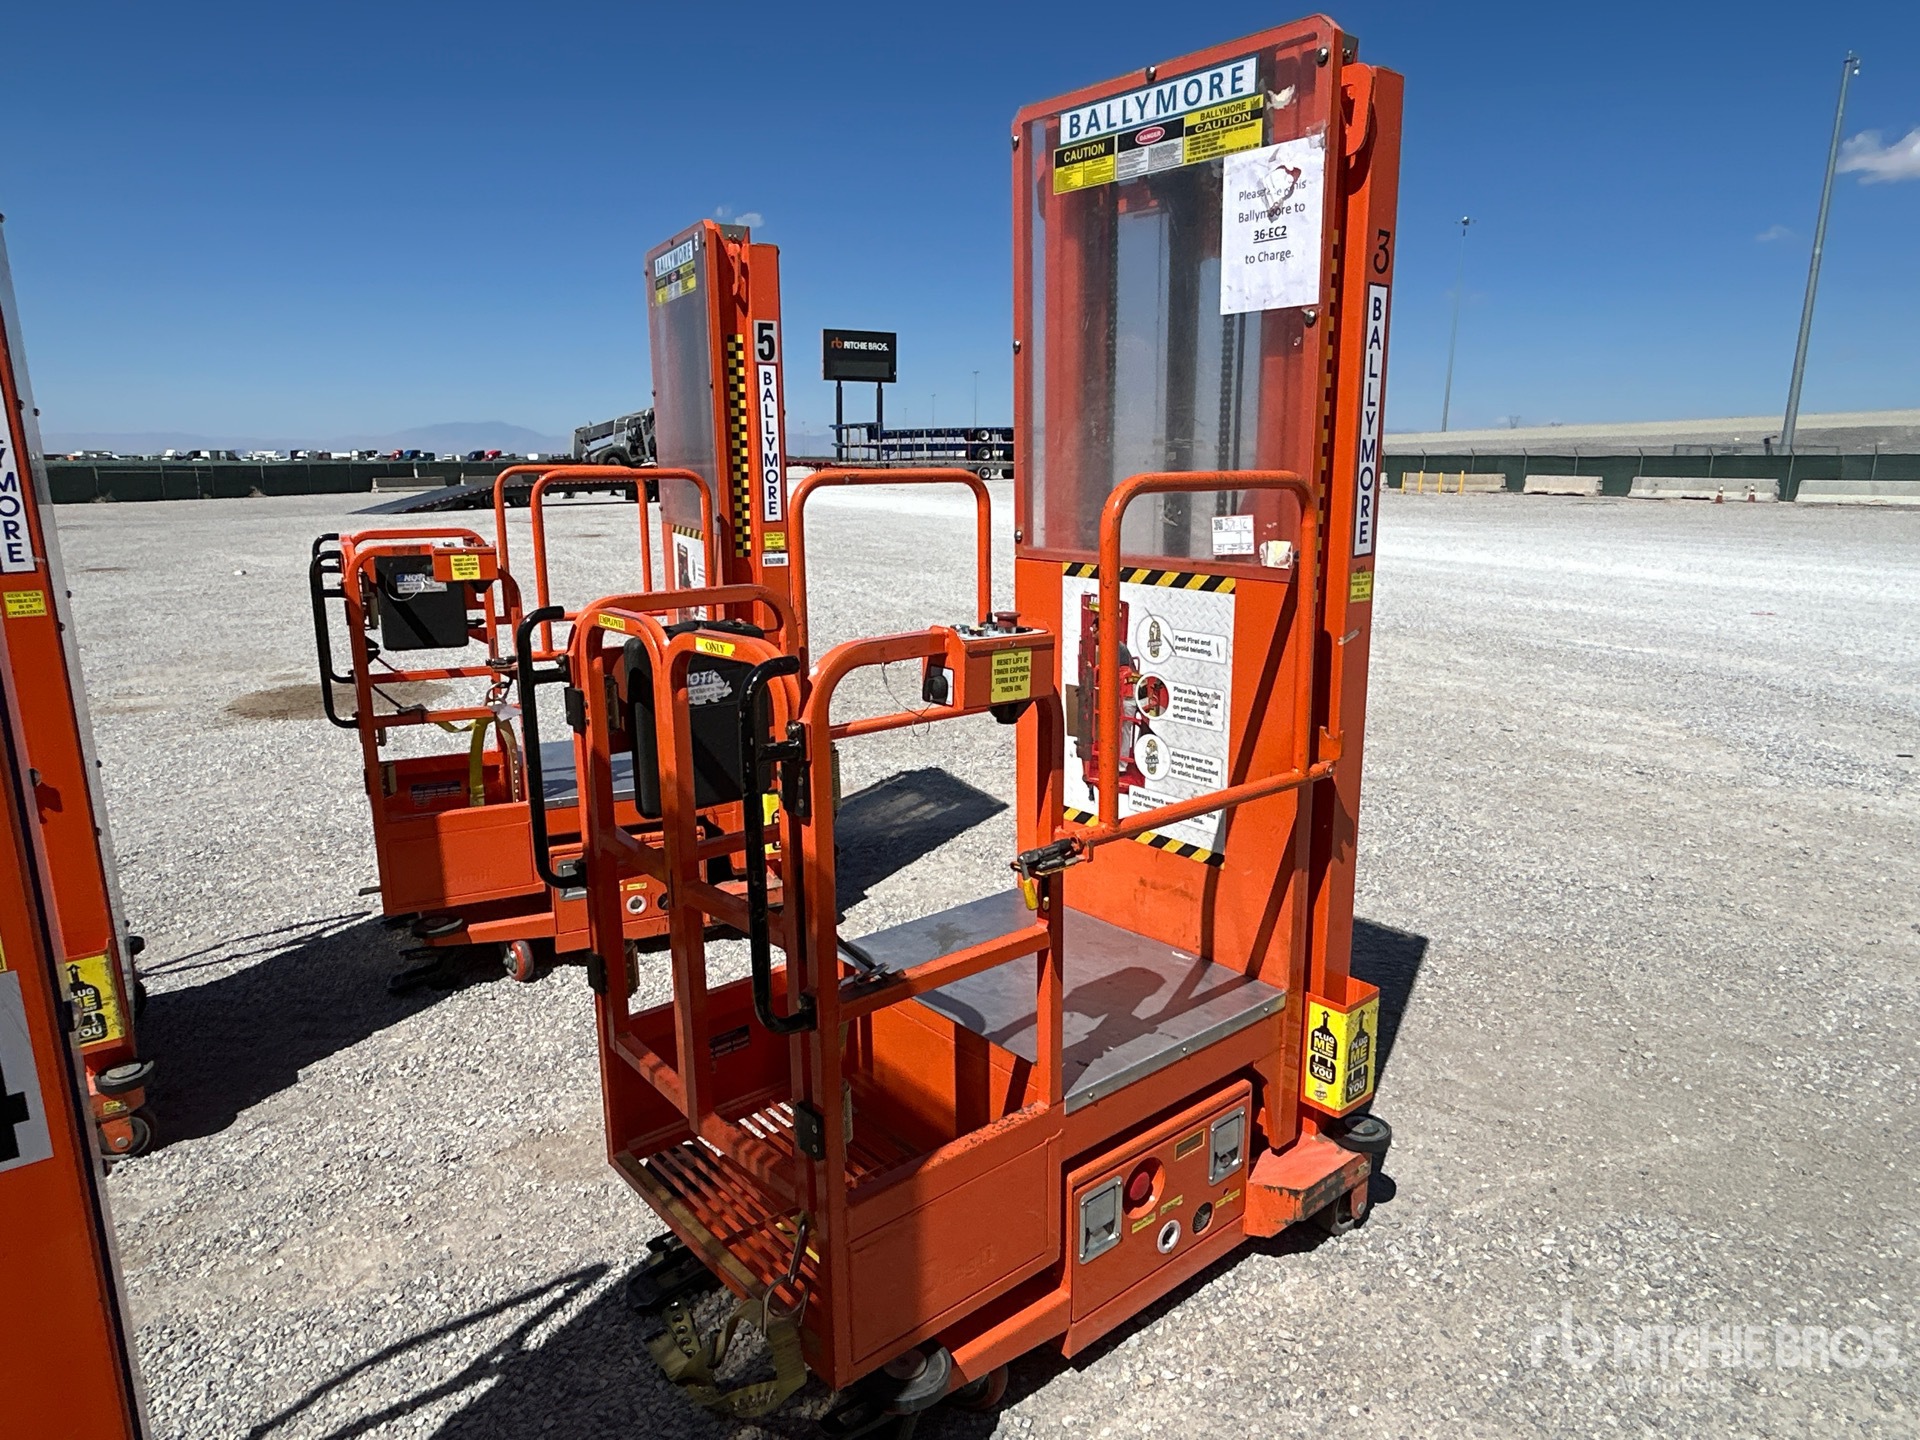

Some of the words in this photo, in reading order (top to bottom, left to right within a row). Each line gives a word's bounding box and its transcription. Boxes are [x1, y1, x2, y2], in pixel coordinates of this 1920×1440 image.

[1069, 65, 1245, 138] BALLYMORE
[1200, 102, 1246, 121] BALLYMORE
[1195, 112, 1251, 133] CAUTION
[1139, 130, 1162, 142] DANGER
[1064, 142, 1105, 162] CAUTION
[1294, 203, 1305, 213] to
[1254, 225, 1287, 240] 36-EC2
[1245, 255, 1255, 264] to
[1258, 250, 1294, 262] Charge.
[1373, 229, 1391, 274] 3
[758, 322, 775, 361] 5
[843, 341, 867, 350] RITCHIE
[1359, 297, 1382, 545] BALLYMORE
[763, 371, 778, 515] BALLYMORE
[705, 641, 725, 653] ONLY
[71, 987, 95, 999] LUG
[81, 1026, 102, 1037] OU
[1314, 1030, 1335, 1044] PLUG
[1314, 1037, 1335, 1054] ME
[1351, 1044, 1367, 1064] ME
[1312, 1064, 1332, 1079] YOU
[1349, 1078, 1365, 1095] YOU
